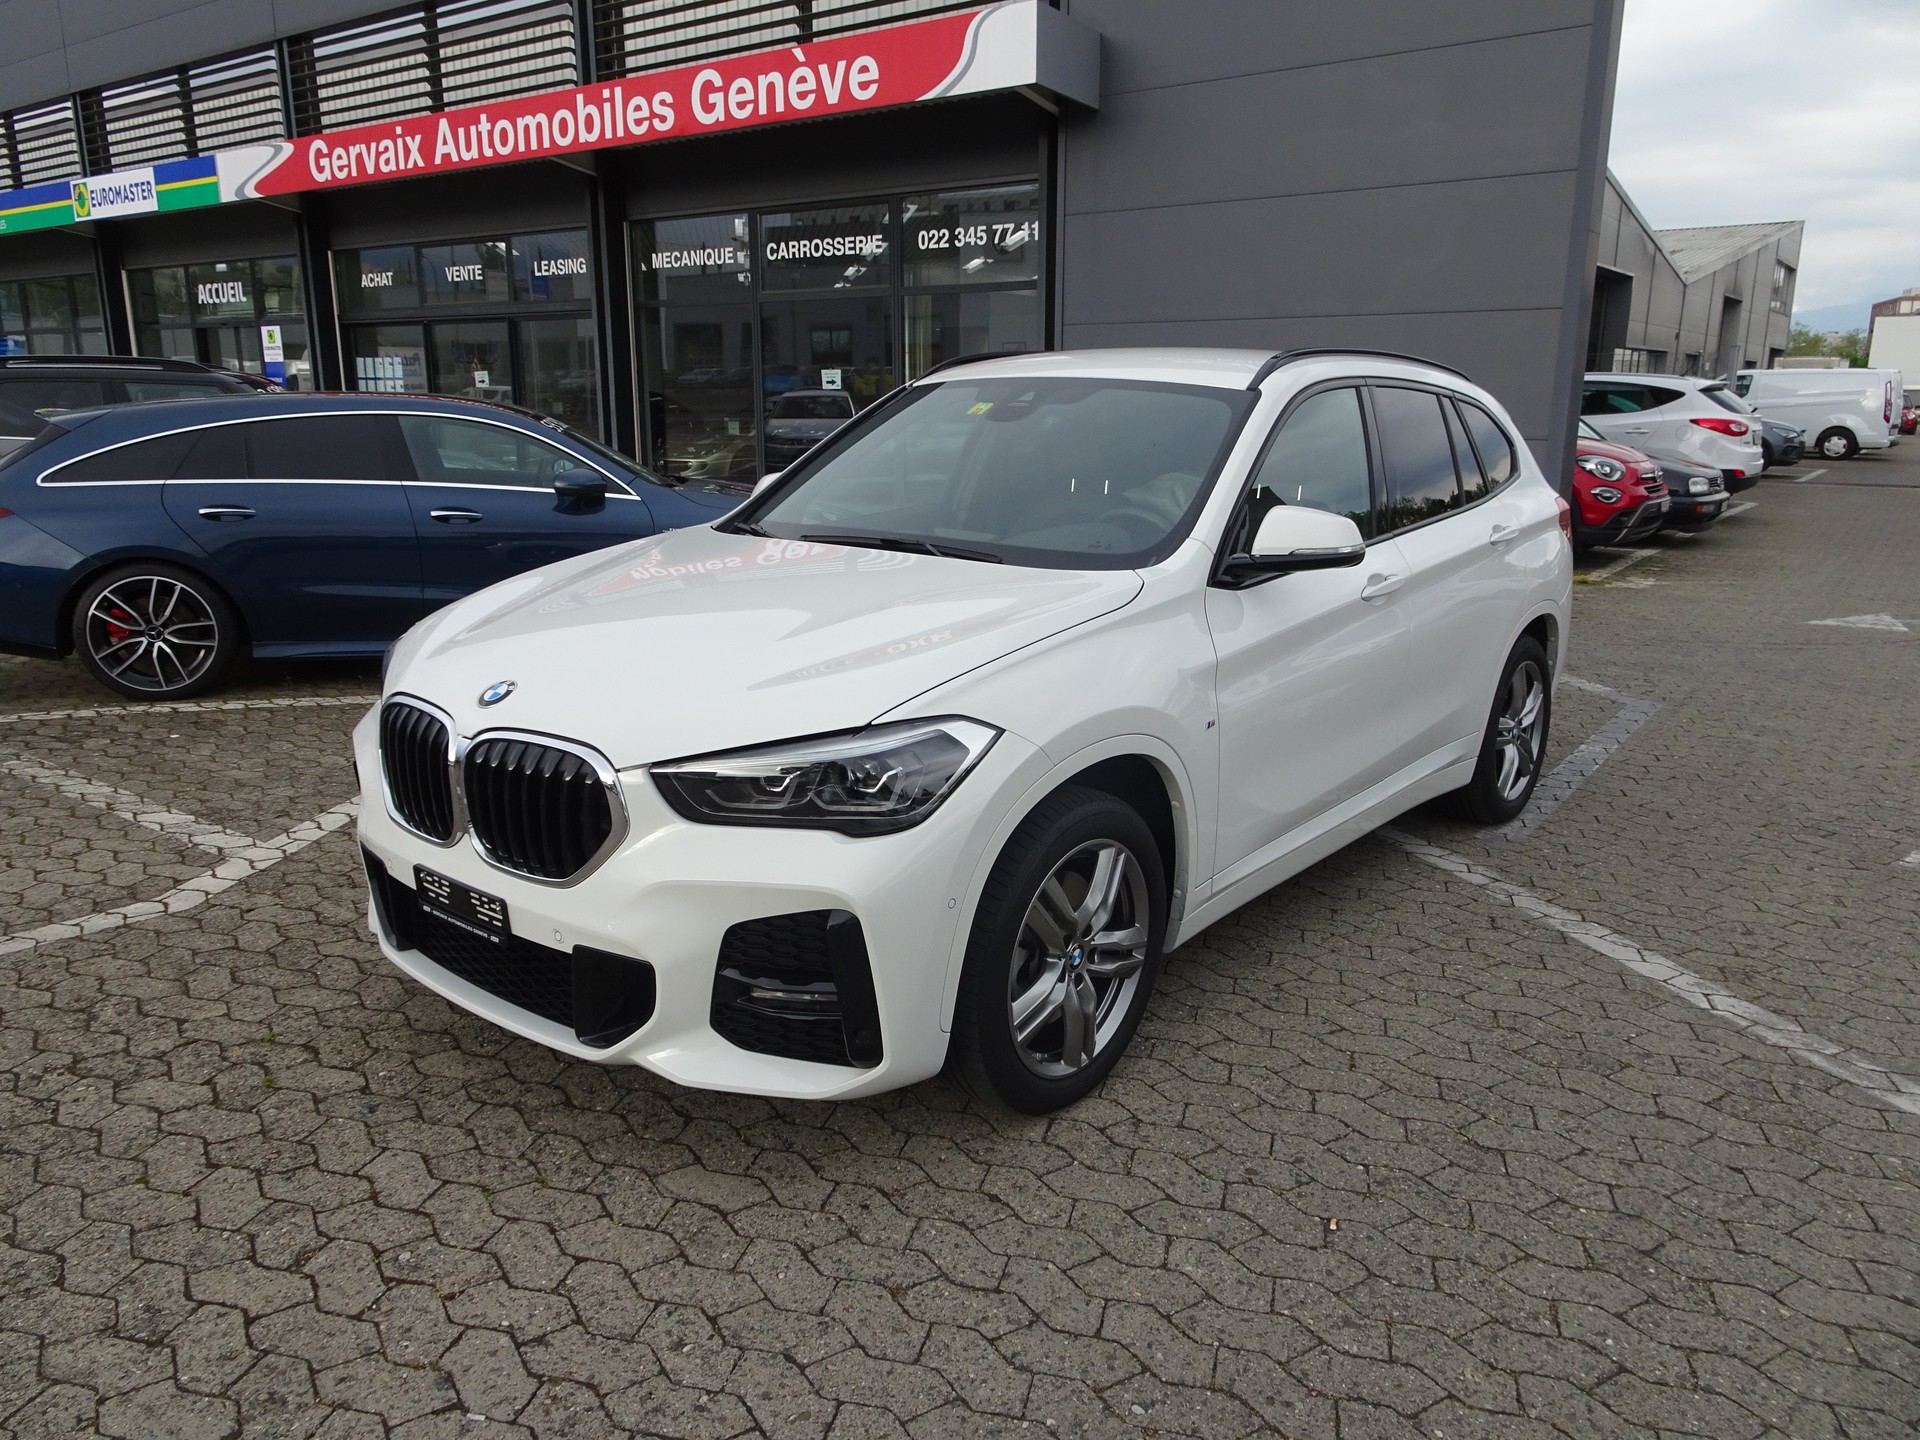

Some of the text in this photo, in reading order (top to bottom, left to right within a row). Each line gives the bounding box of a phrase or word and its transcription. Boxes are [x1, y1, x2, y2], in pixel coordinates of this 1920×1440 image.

[308, 48, 880, 182] Gervaix Automobiles Genève
[90, 181, 153, 207] EUROMASTER
[918, 221, 1039, 250] 022 345 77 11
[652, 248, 734, 269] MECANIQUE
[766, 235, 884, 260] CARROSSERIE
[445, 265, 483, 282] VENTE
[534, 258, 586, 277] LEASING
[361, 272, 393, 288] ACHAT
[198, 281, 247, 304] ACCUEIL
